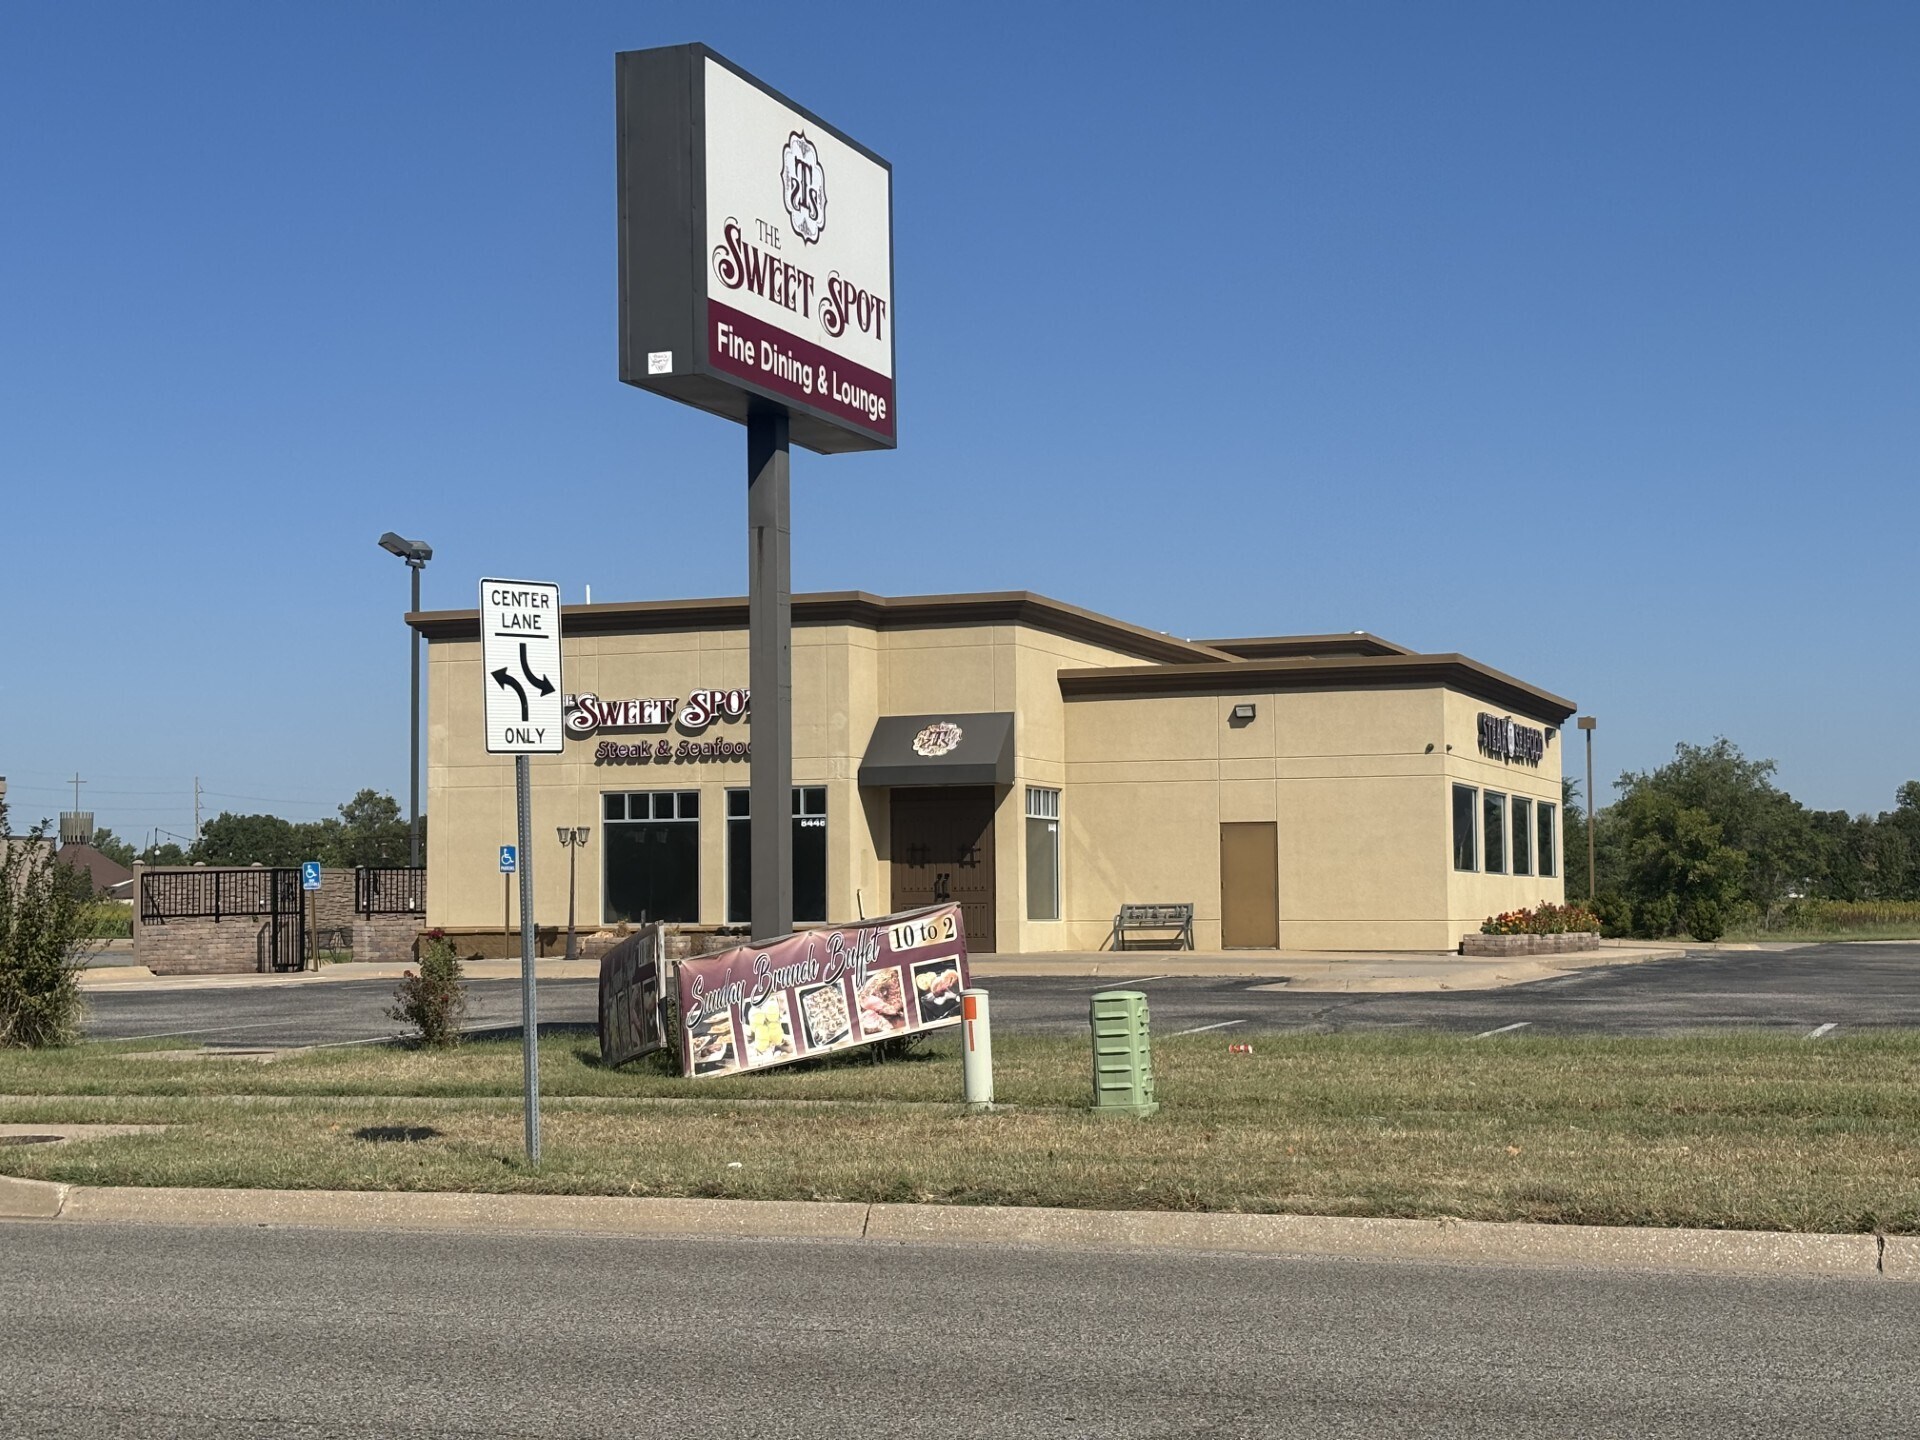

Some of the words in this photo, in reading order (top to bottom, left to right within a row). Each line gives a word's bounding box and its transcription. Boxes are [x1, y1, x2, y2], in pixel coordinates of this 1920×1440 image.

[755, 218, 781, 250] THE
[712, 216, 815, 319] SWEET
[818, 270, 887, 342] SPOT
[717, 321, 755, 366] Fine
[760, 339, 813, 394] Dining
[817, 364, 829, 396] &
[832, 370, 887, 422] Lounge
[491, 589, 550, 609] CENTER
[501, 612, 542, 630] LANE
[566, 692, 678, 732] SWEET
[504, 726, 546, 744] ONLY
[597, 740, 651, 759] Steak
[656, 740, 670, 757] &
[891, 926, 915, 949] 10
[920, 922, 938, 940] to
[943, 917, 954, 940] 2
[686, 969, 747, 1030] Sunday
[750, 943, 820, 1009] Brunch
[822, 925, 889, 988] Buffet
